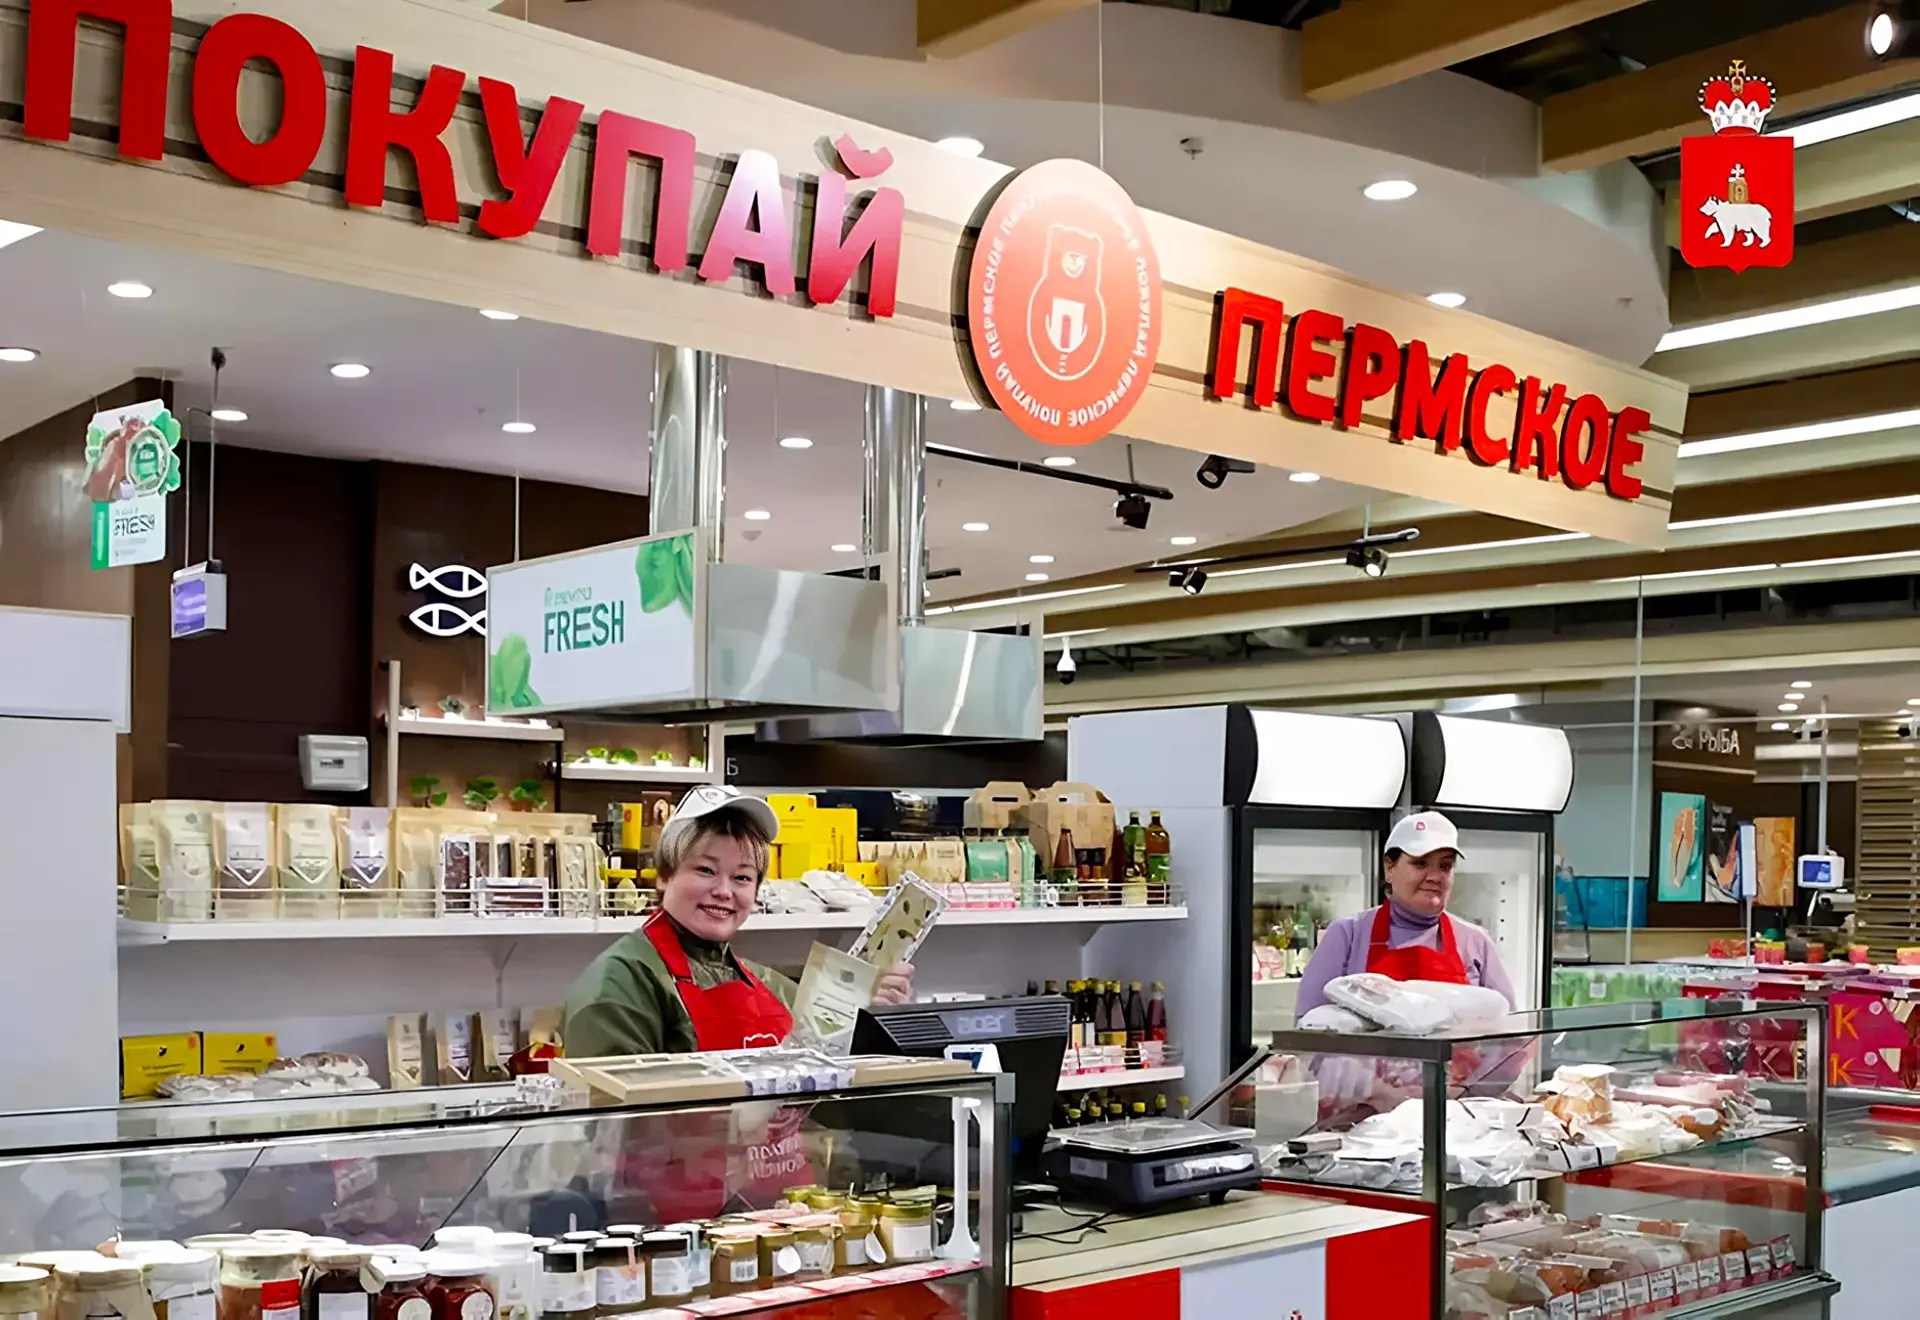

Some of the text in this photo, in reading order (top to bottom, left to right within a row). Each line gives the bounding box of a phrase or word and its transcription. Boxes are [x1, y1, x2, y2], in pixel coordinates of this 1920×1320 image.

[24, 0, 1650, 499] ПОКУПАЙ ПЕРМСКОЕ
[544, 600, 624, 654] FRESH
